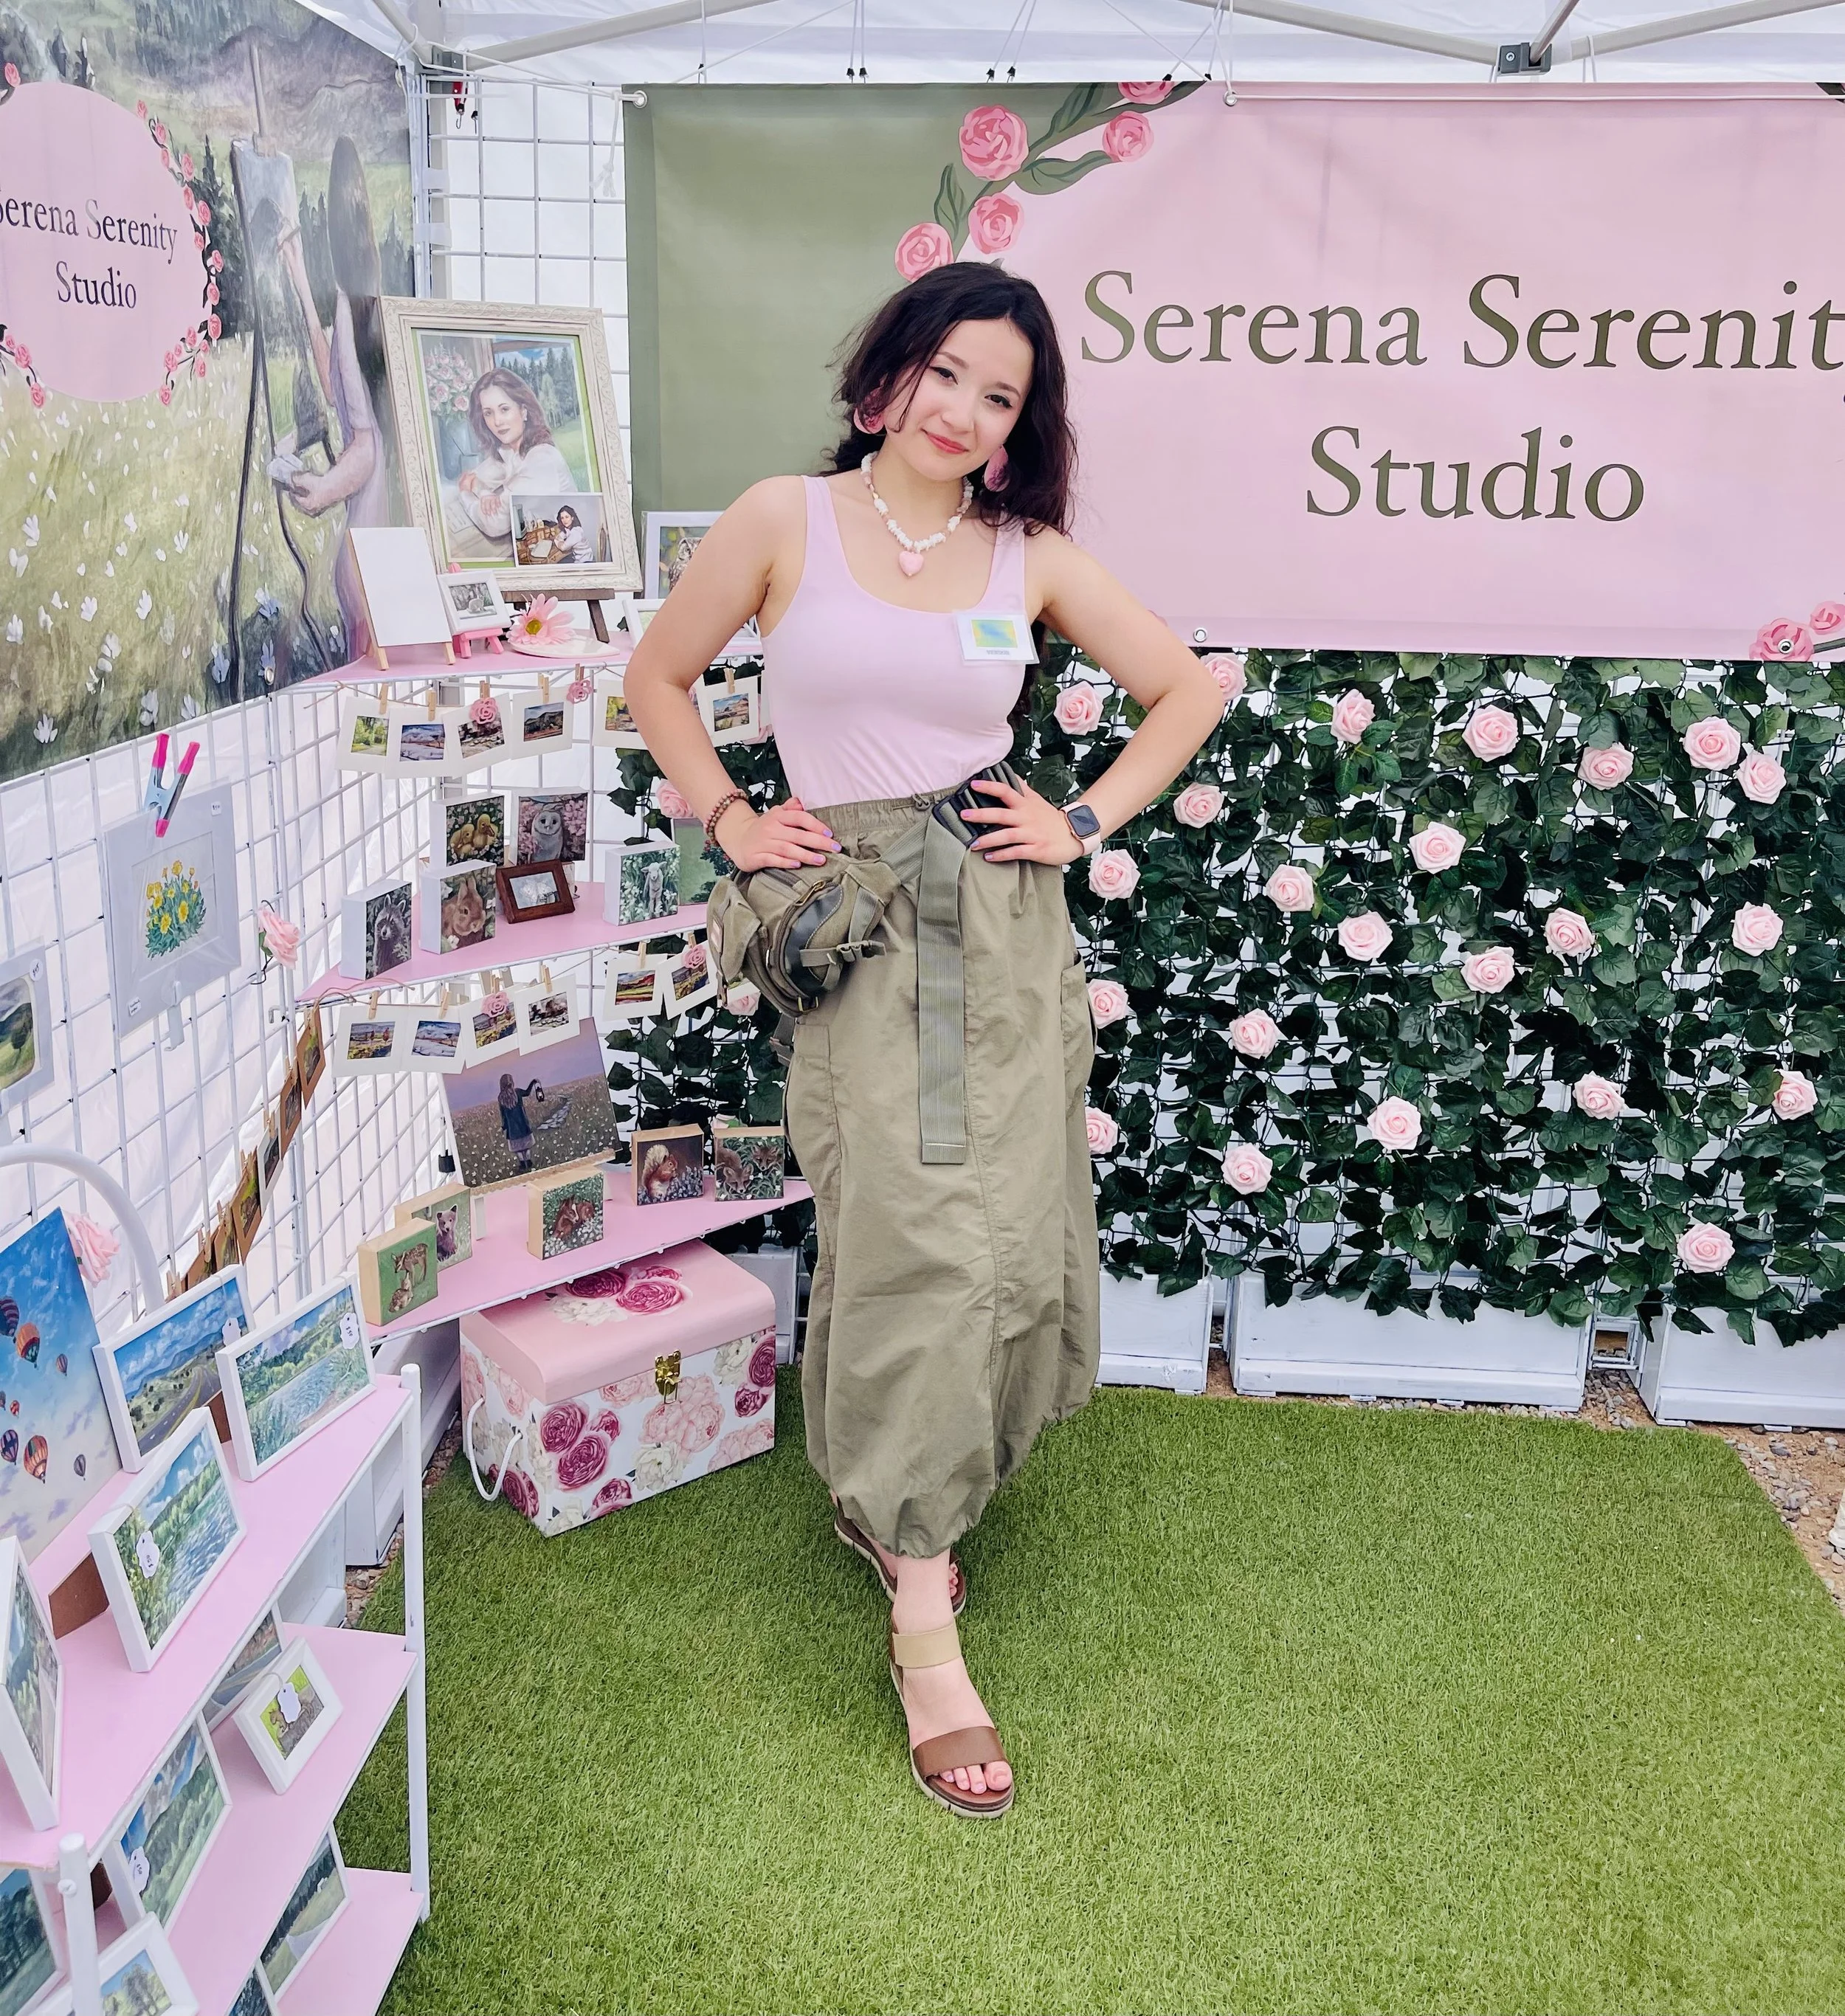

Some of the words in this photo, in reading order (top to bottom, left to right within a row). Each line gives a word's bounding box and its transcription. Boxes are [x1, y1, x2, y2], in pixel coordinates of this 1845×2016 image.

[85, 198, 178, 265] Serenity
[55, 260, 137, 308] Studio
[1082, 270, 1428, 366] Serena
[1464, 274, 1845, 371] Serenit
[1306, 426, 1644, 522] Studio
